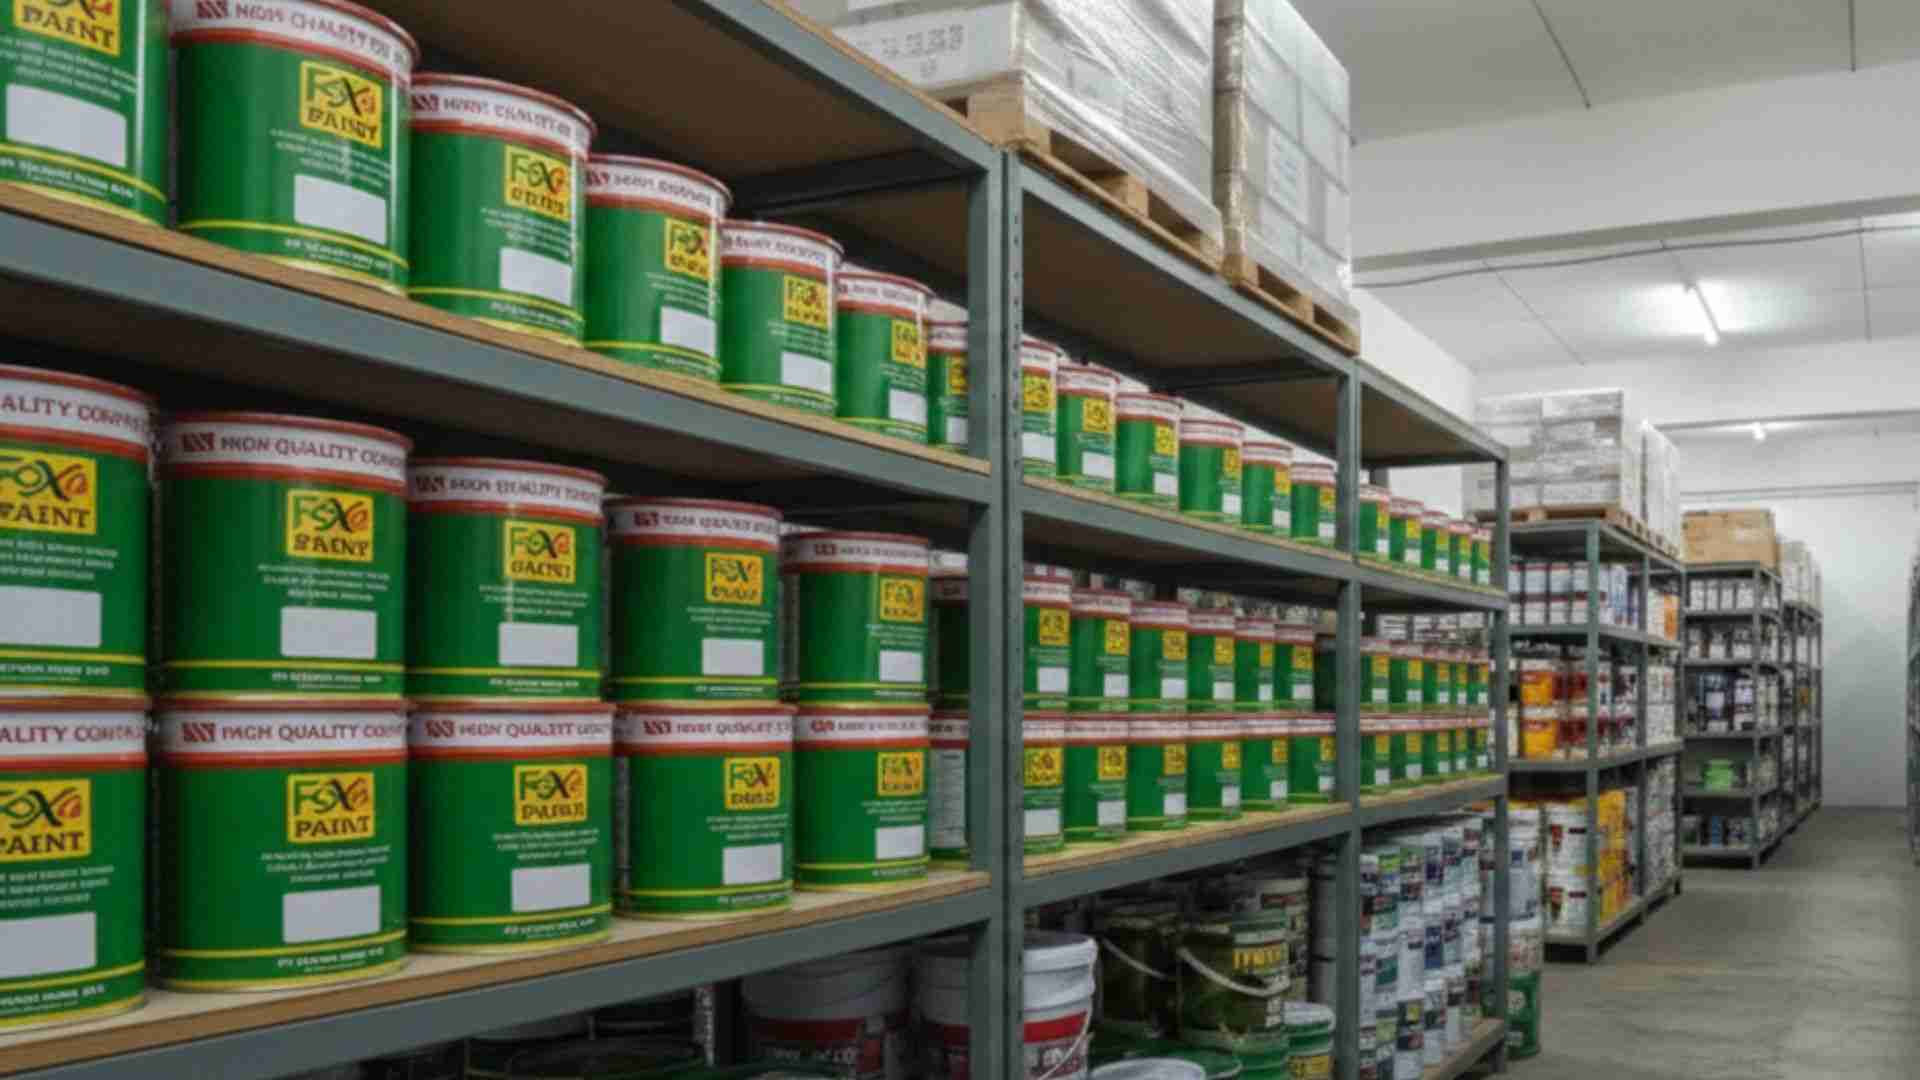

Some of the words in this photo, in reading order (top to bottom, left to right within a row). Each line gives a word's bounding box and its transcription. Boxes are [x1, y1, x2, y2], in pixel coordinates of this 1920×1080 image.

[22, 5, 114, 49] PAINT
[275, 438, 357, 465] QUALITY
[279, 723, 358, 742] QUALITY
[294, 815, 370, 838] PAINT
